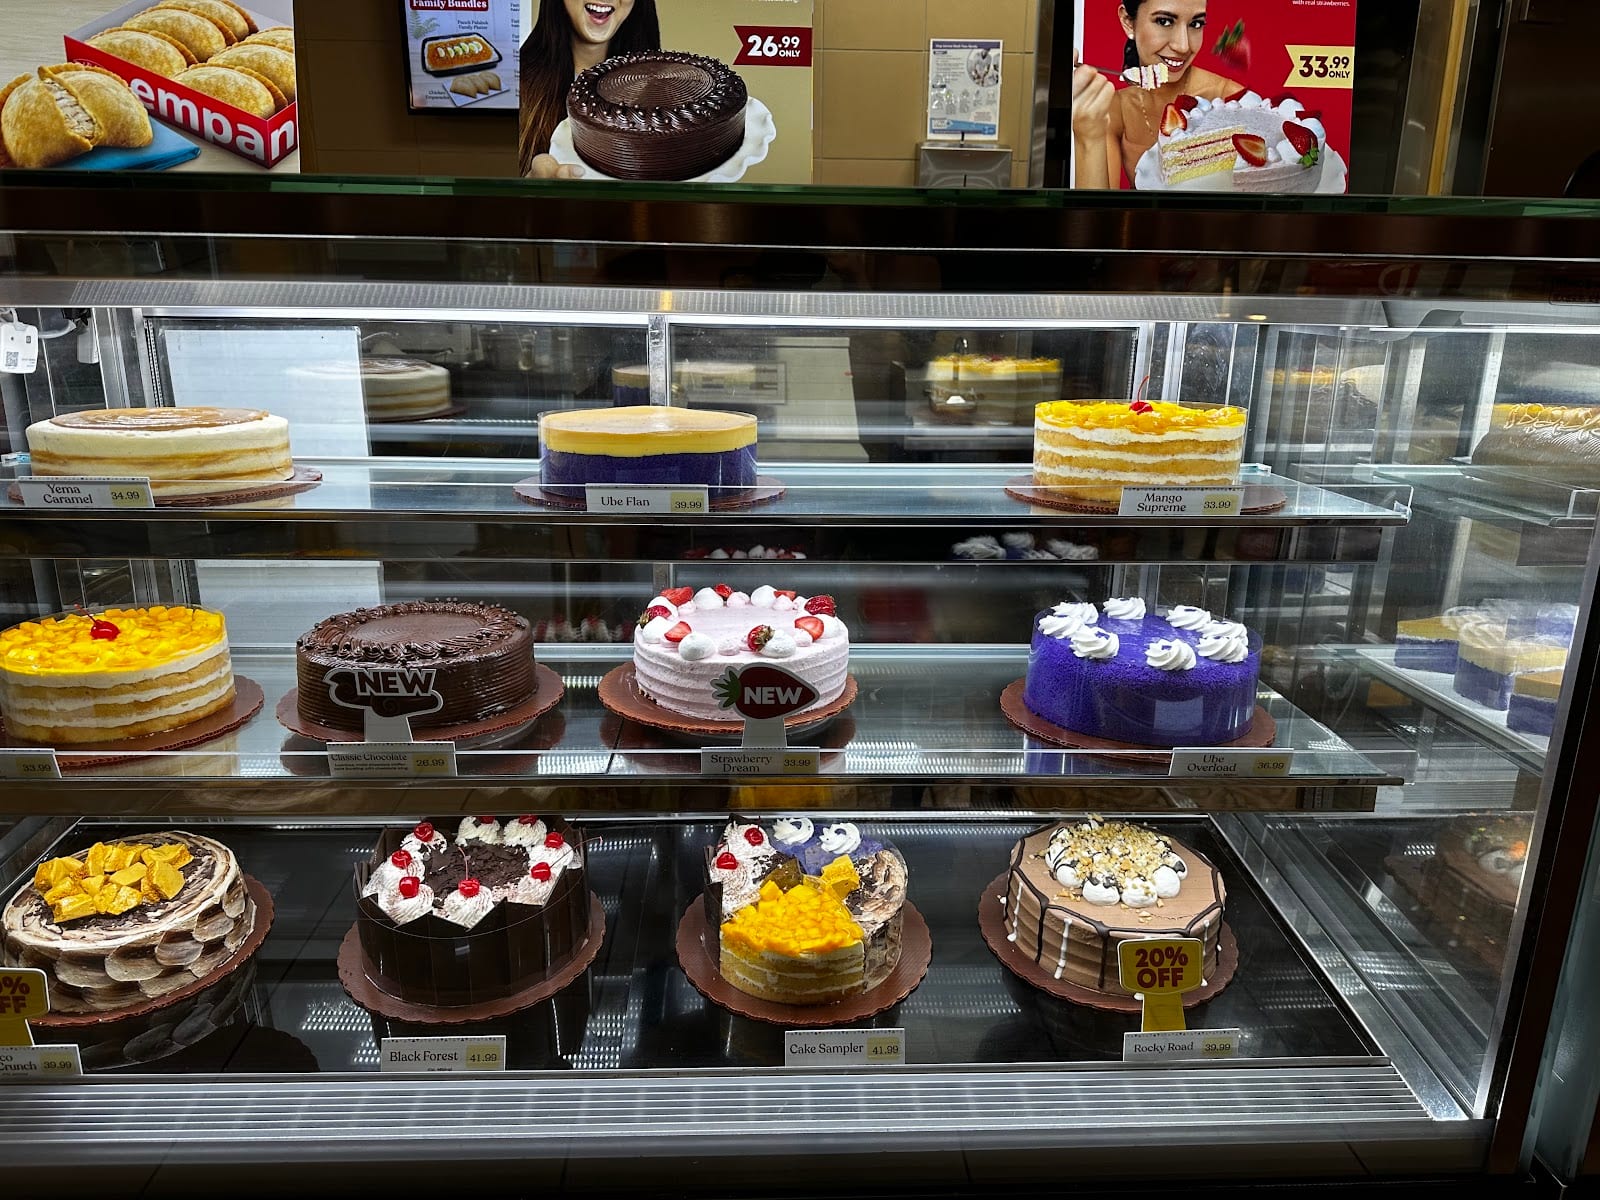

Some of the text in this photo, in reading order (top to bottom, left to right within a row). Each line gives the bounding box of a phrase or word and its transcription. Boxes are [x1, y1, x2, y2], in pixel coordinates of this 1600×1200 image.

[412, 0, 488, 9] Family Bundles
[747, 34, 801, 57] 26.99
[778, 50, 801, 58] ONLY
[1299, 55, 1350, 78] 33.99
[1328, 70, 1351, 79] ONLY
[47, 483, 81, 494] Yema
[42, 493, 94, 505] Caramel
[110, 491, 141, 501] 34.99
[600, 496, 650, 507] Ube Flan
[1144, 492, 1183, 504] Mango
[674, 501, 702, 509] 39.99
[1136, 502, 1187, 515] Supreme
[1203, 500, 1231, 509] 33.99
[357, 671, 433, 694] NEW
[743, 686, 803, 705] NEW
[330, 752, 408, 762] Classic Chocolate
[416, 758, 445, 767] 26.99
[710, 753, 773, 766] Strawberry
[783, 758, 812, 767] 33.99
[1202, 753, 1225, 764] Ube
[22, 763, 52, 772] 33.99
[722, 763, 760, 773] Dream
[1187, 762, 1238, 772] Overload
[1257, 761, 1285, 770] 36.99
[1135, 946, 1189, 968] 20%
[1136, 967, 1184, 989] OFF
[789, 1042, 865, 1056] Cake Sampler
[872, 1044, 899, 1055] 41.99
[1133, 1041, 1194, 1054] Rocky Road
[1205, 1042, 1231, 1052] 39.99
[389, 1050, 459, 1062] Black Forest
[469, 1053, 498, 1062] 41.99
[43, 1060, 73, 1070] 39.99
